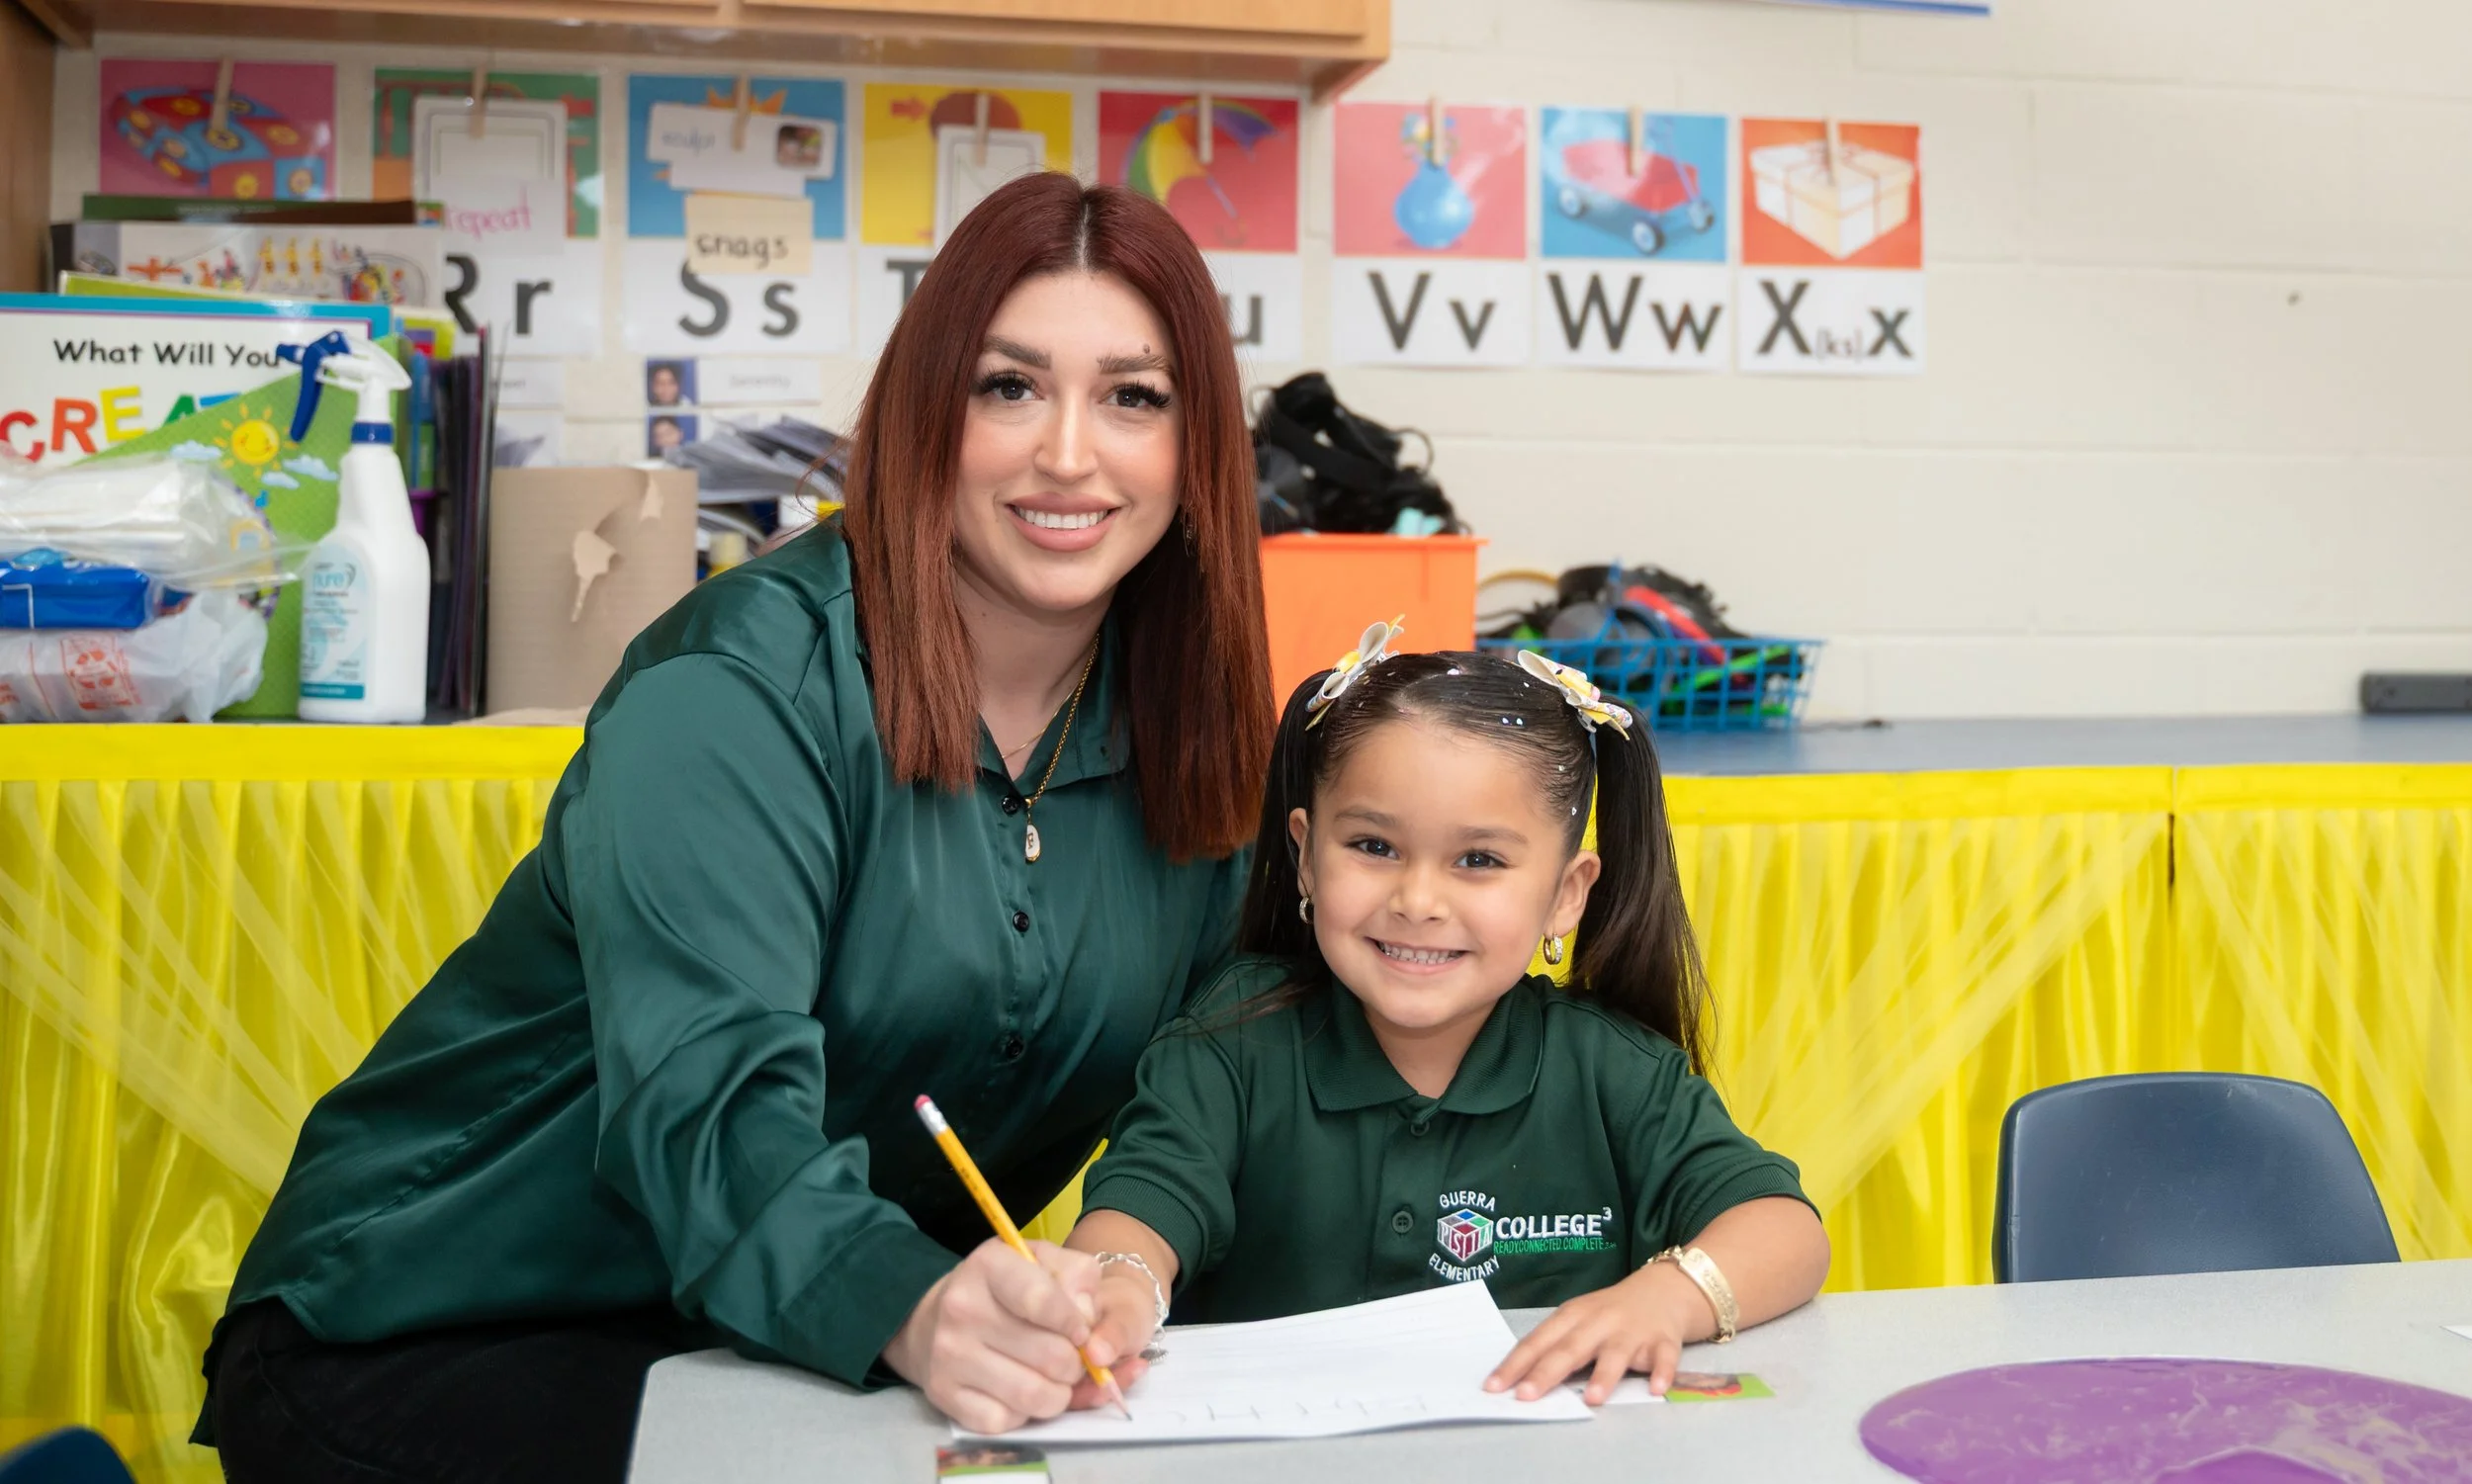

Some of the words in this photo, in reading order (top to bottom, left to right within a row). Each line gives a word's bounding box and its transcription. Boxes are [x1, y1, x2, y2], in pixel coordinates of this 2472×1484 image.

[53, 339, 142, 365] What
[153, 342, 215, 366] Will
[223, 344, 281, 369] You
[1439, 1190, 1496, 1212] GUERRA
[1429, 1253, 1499, 1282] ELEMENTARY
